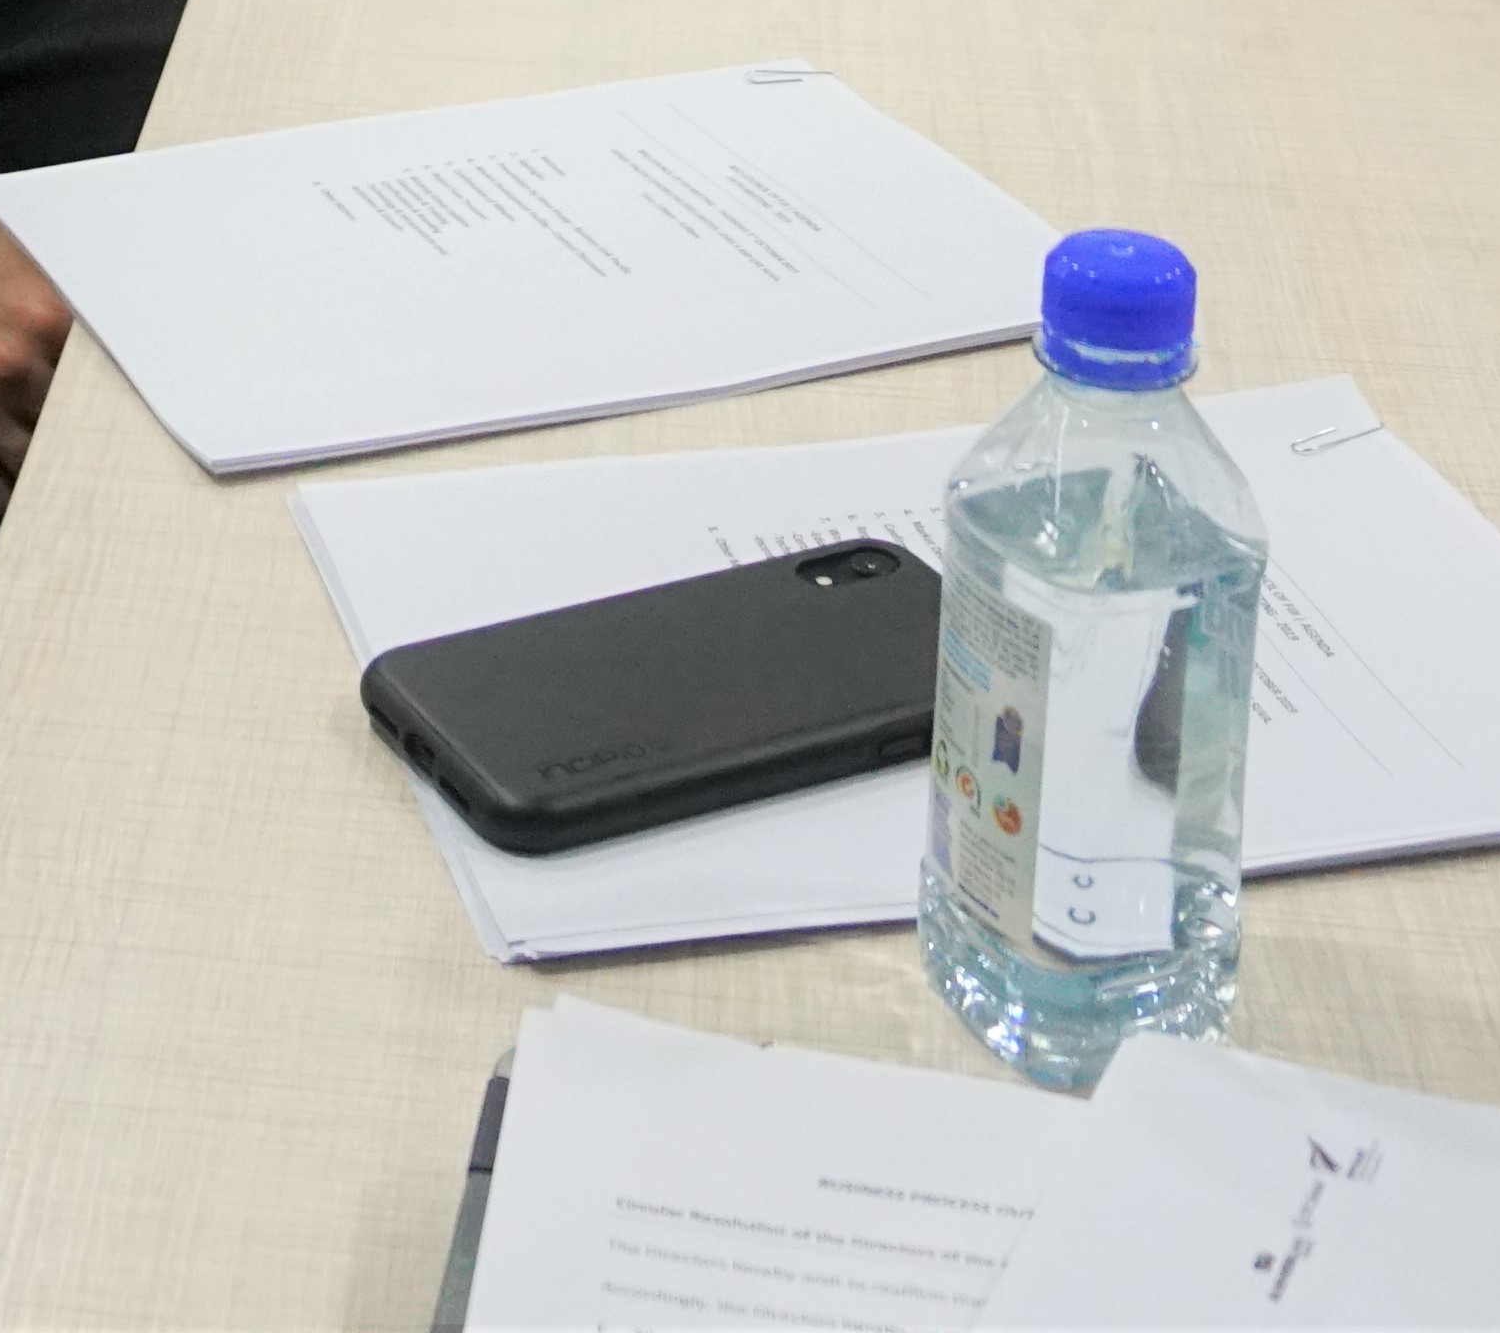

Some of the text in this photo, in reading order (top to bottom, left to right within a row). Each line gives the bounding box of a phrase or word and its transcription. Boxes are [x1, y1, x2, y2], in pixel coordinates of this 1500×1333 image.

[1301, 623, 1335, 658] AGENDA
[818, 1175, 906, 1202] BUSINESS
[909, 1191, 992, 1216] PROCESS
[615, 1197, 685, 1219] Circular
[689, 1209, 787, 1237] Resolution
[791, 1227, 812, 1242] of
[816, 1231, 845, 1246] the
[850, 1237, 935, 1259] Directors
